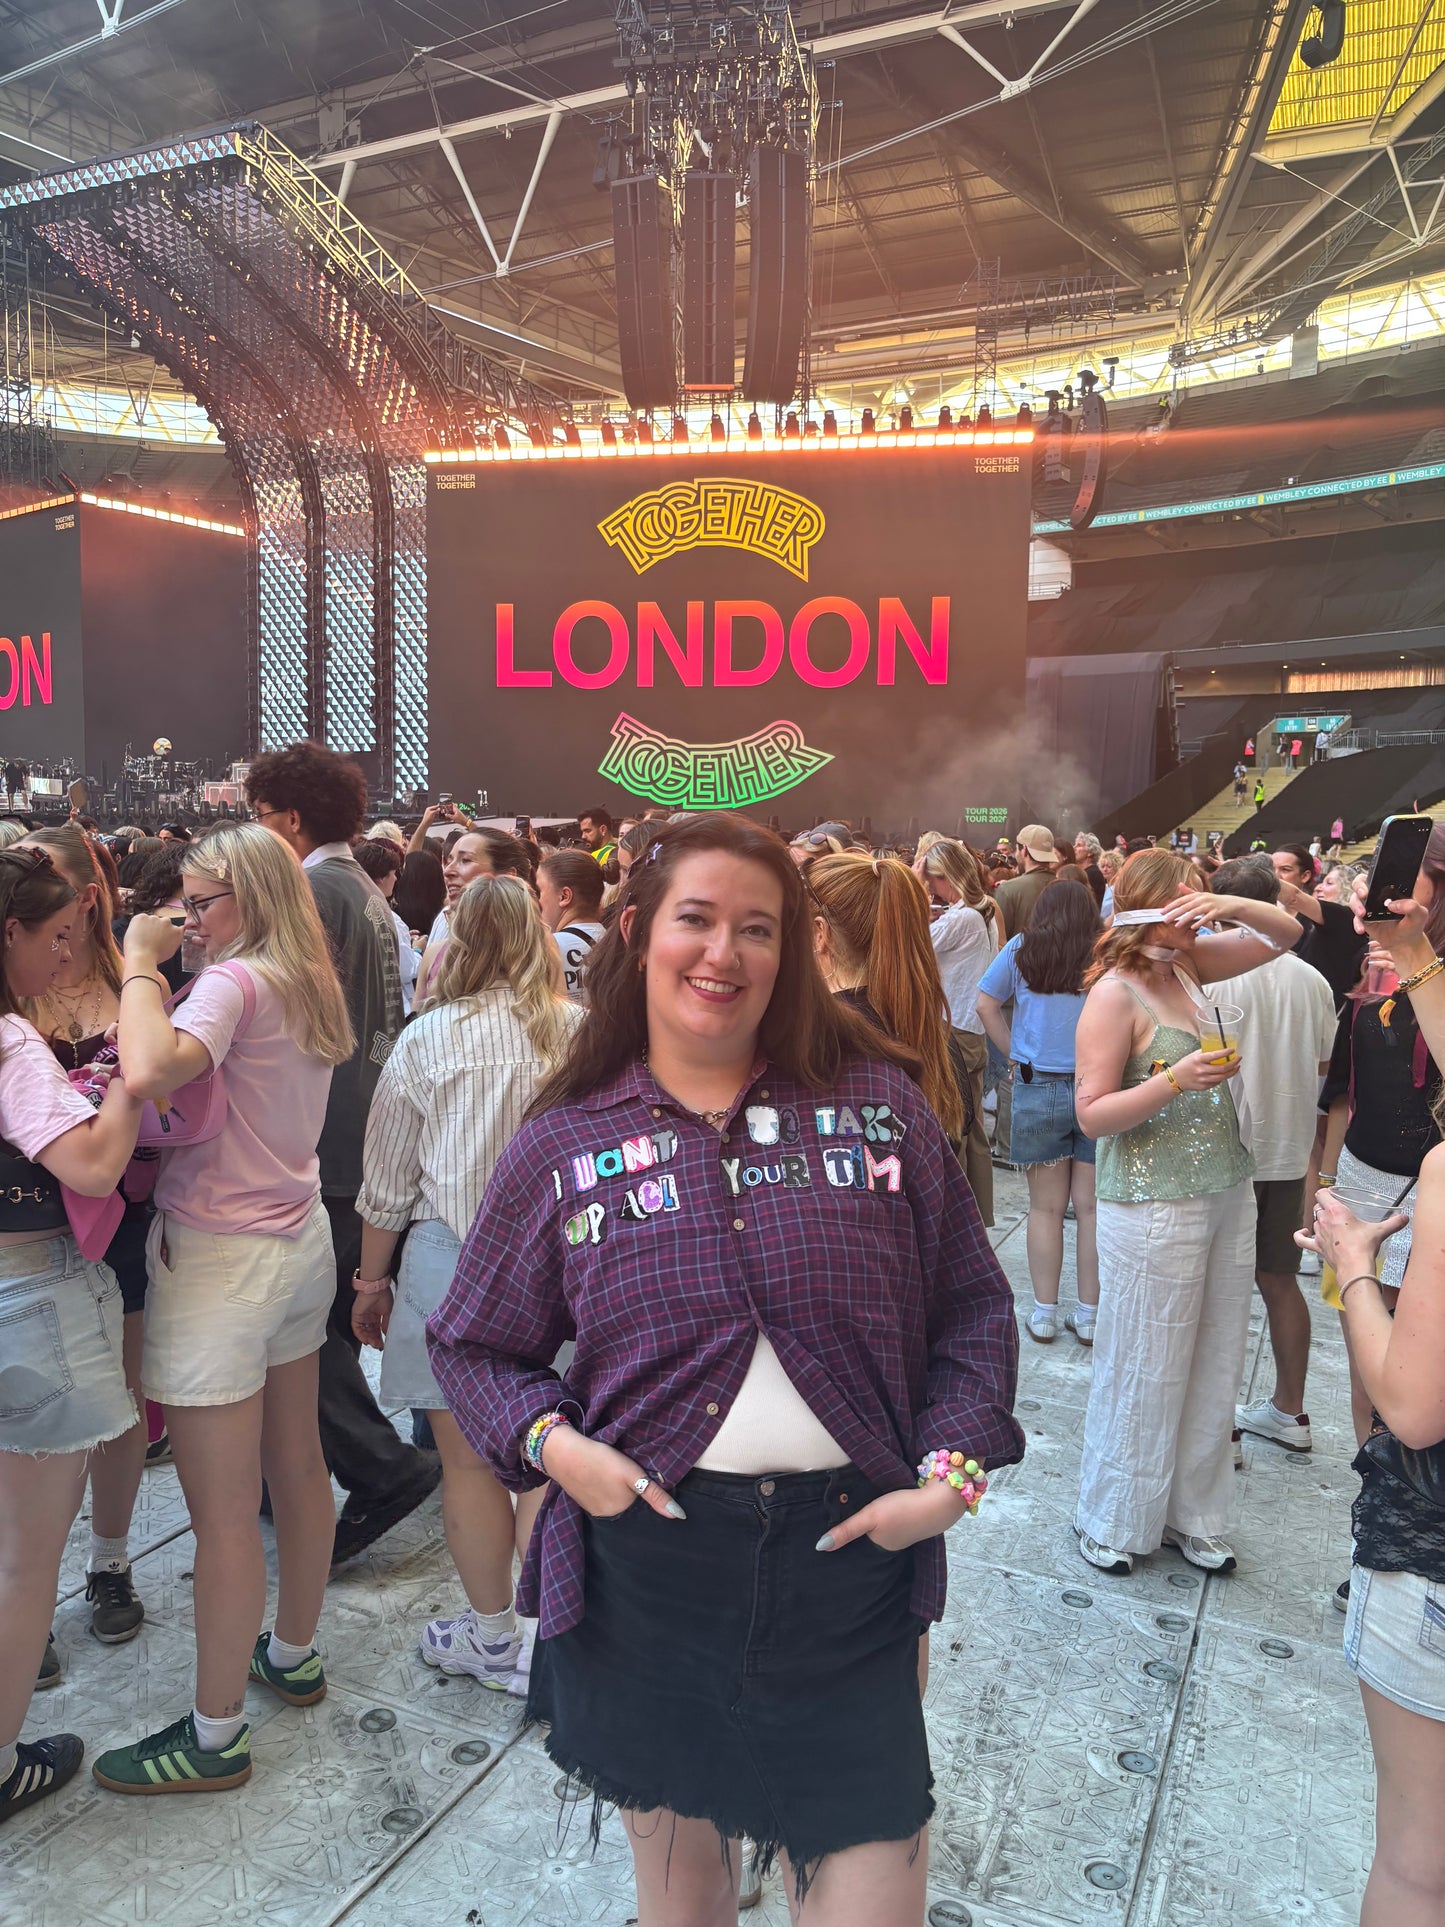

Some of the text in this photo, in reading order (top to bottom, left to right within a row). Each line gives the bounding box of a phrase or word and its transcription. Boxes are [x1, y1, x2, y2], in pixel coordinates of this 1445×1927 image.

[974, 456, 1020, 465] TOGETHER
[974, 464, 1020, 474] TOGETHER
[1397, 465, 1442, 481] WEMBLEY
[435, 473, 476, 482] TOGETHER
[435, 481, 476, 490] TOGETHER
[1265, 476, 1388, 502] WEMBLEY CONNECTED BY EE
[1145, 496, 1257, 519] WEMBLEY CONNECTED BY EE
[1117, 514, 1128, 522] BY
[1128, 512, 1138, 521] EE
[596, 477, 826, 583] TOGETHER
[495, 596, 951, 689] LONDON
[597, 711, 836, 810] TOGETHER
[965, 807, 988, 815] TOUR
[965, 815, 988, 823] TOUR
[745, 1105, 801, 1146] TO
[619, 1174, 681, 1221] ALL
[720, 1153, 813, 1198] YOUR
